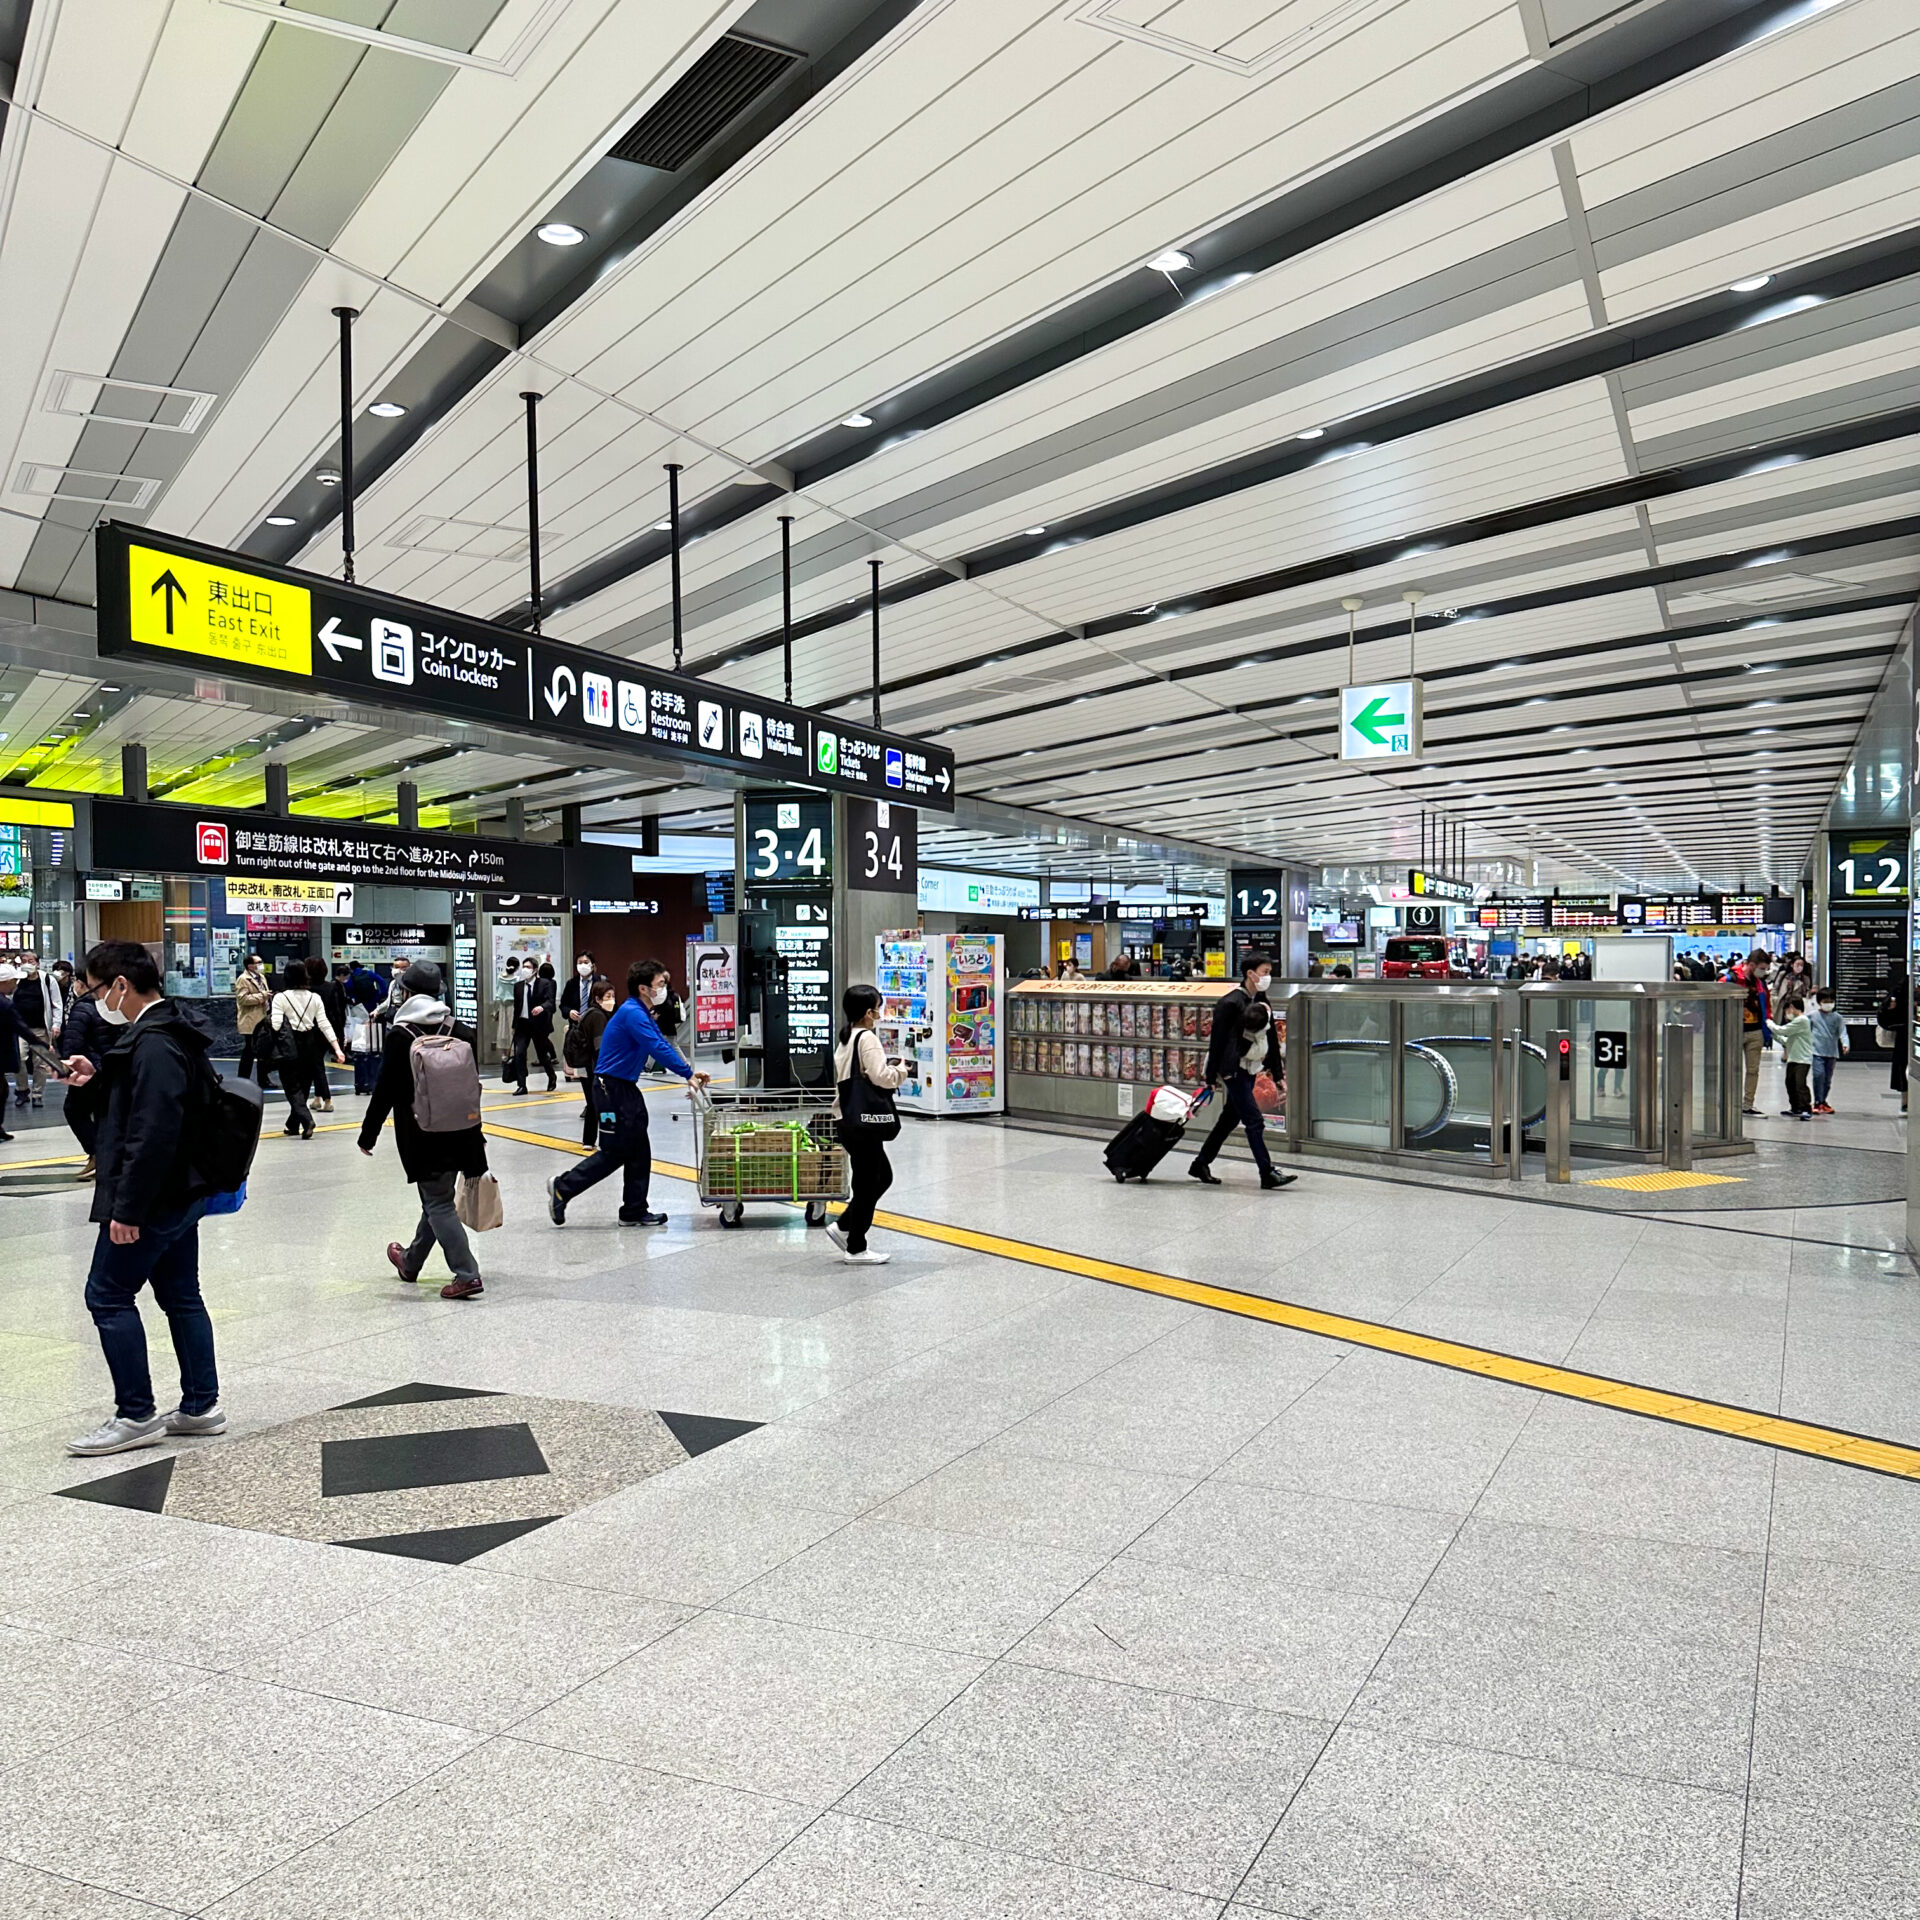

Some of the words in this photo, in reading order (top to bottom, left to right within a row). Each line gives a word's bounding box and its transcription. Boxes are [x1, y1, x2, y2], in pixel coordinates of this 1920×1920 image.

[208, 580, 272, 616] 東出口
[208, 609, 243, 633] East
[250, 618, 281, 641] Exit
[420, 631, 517, 671] コインロッカー
[421, 657, 451, 679] Coin
[453, 663, 499, 689] Lockers
[650, 689, 686, 715] お手洗
[651, 710, 692, 732] Restroom
[766, 717, 795, 741] 待合室
[766, 736, 787, 757] Waiting
[839, 737, 881, 760] きっぷうりば
[839, 754, 861, 770] Tickets
[904, 769, 934, 786] Shinkansen
[235, 829, 462, 866] 御堂筋線は改札を出て右へ進み2Fへ
[480, 852, 505, 866] 150m
[235, 854, 255, 866] Turn
[256, 856, 277, 870] right
[278, 859, 293, 868] out
[293, 858, 303, 869] of
[303, 859, 317, 870] the
[318, 861, 335, 873] gate
[336, 862, 351, 872] and
[351, 864, 362, 875] go
[362, 864, 371, 873] to
[372, 864, 384, 874] the
[385, 865, 399, 876] 2nd
[400, 865, 416, 877] floor
[417, 867, 427, 878] for
[428, 868, 439, 878] the
[467, 871, 491, 884] Subway
[381, 937, 420, 945] Adjustment
[958, 953, 992, 966] いろどり
[1598, 1037, 1624, 1062] 3F
